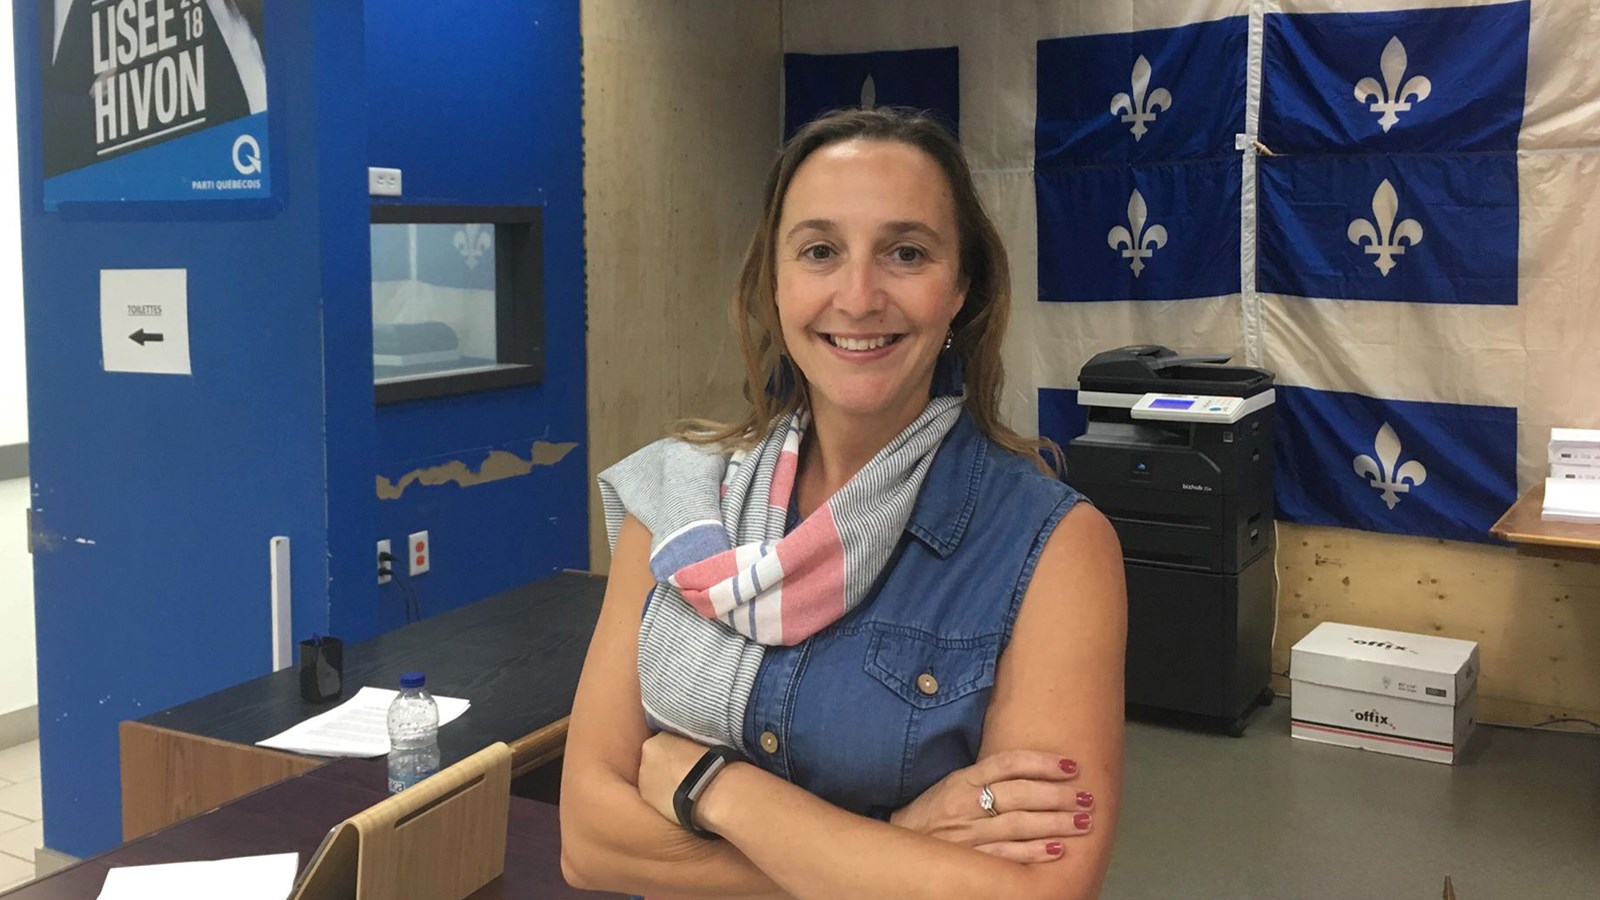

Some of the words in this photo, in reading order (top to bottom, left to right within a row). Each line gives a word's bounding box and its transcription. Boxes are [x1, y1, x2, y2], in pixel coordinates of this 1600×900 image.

[184, 6, 204, 41] 18
[95, 45, 206, 144] HIVON
[192, 180, 215, 190] PARTI
[127, 304, 162, 315] TOILETTES
[1355, 710, 1389, 725] offix
